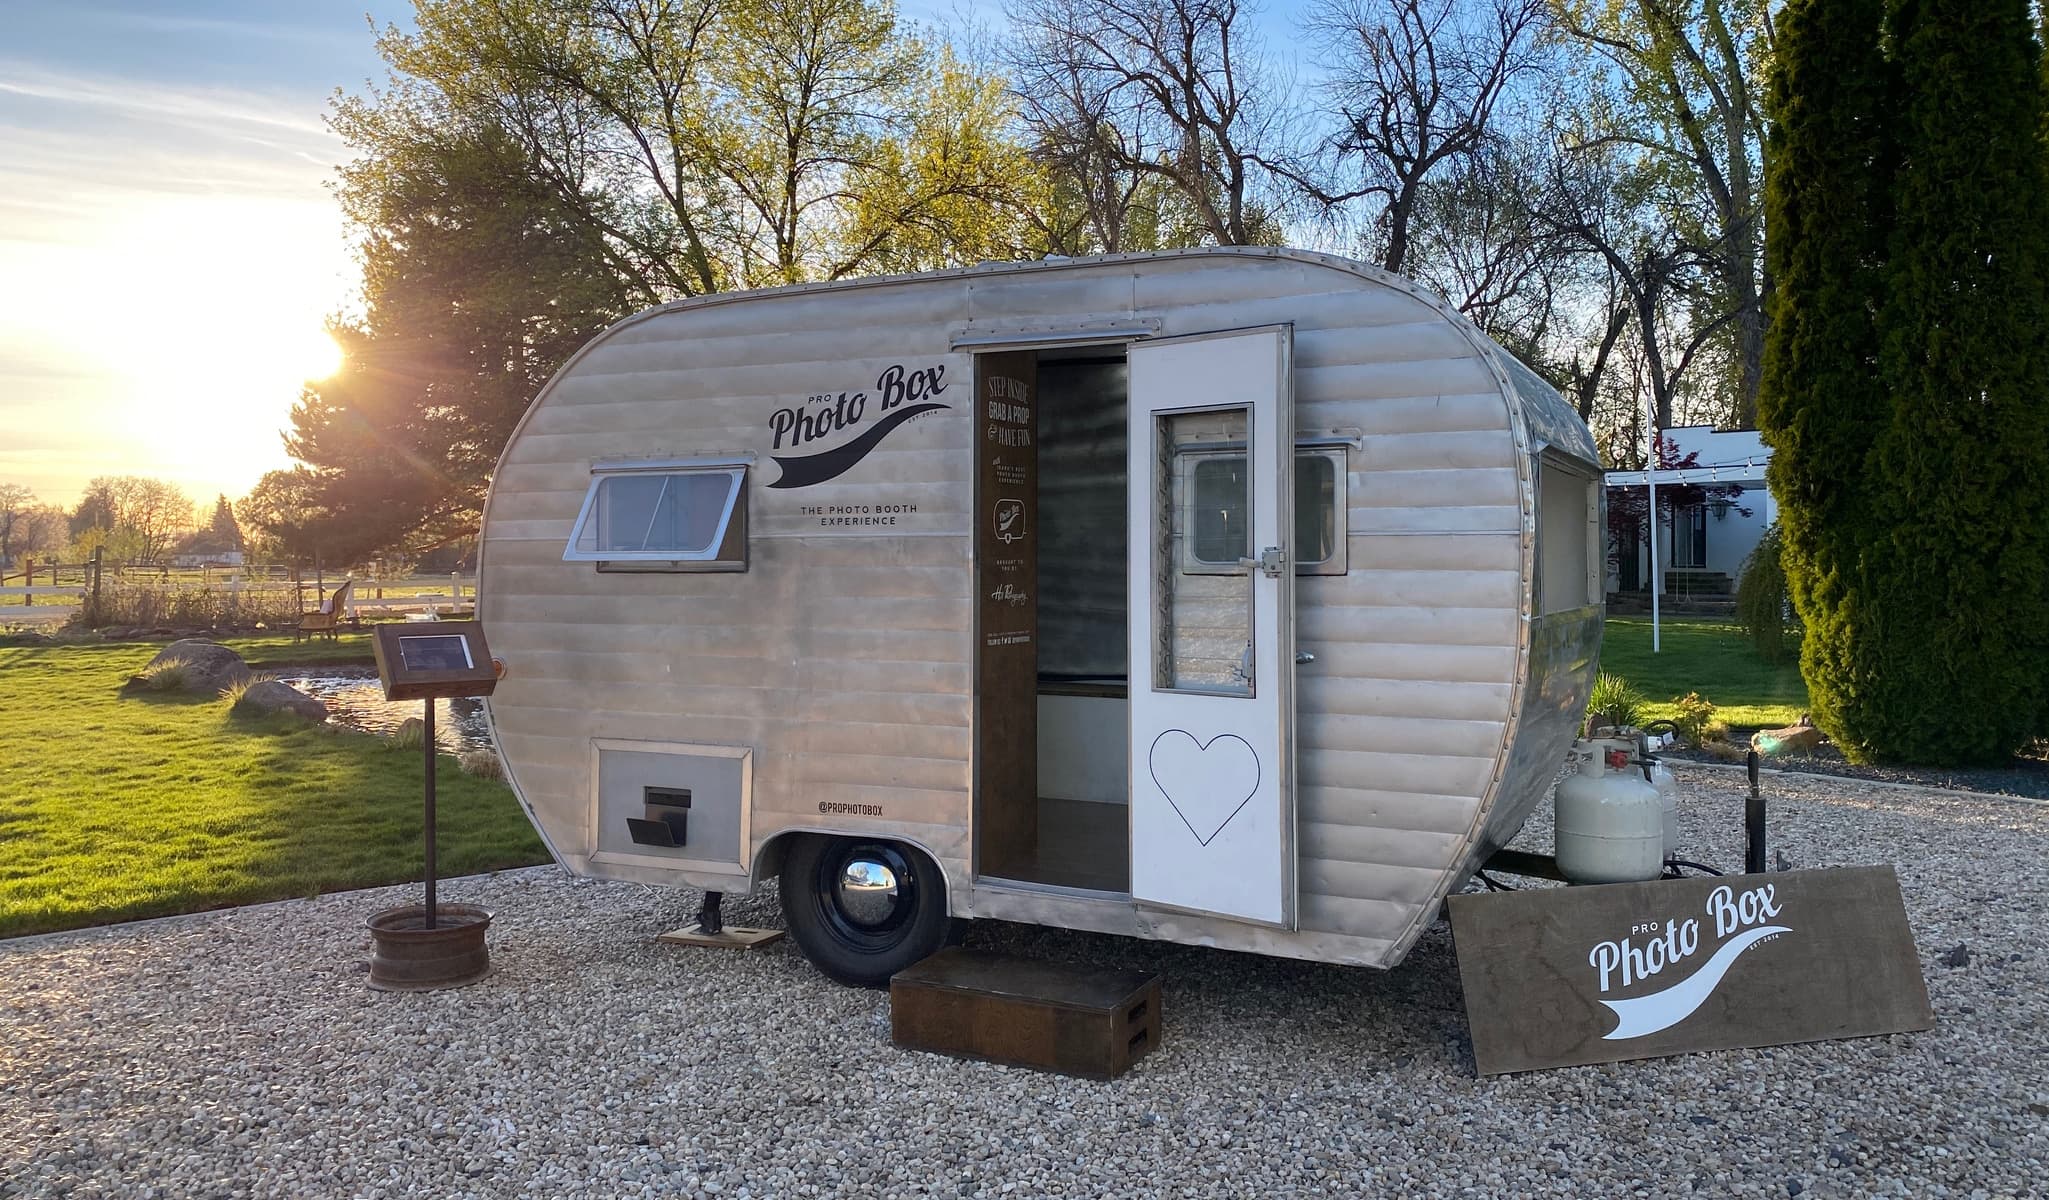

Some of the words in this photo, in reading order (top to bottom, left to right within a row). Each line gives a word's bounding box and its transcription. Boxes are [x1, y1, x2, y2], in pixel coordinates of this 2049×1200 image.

[988, 376, 1006, 398] STEP
[1007, 377, 1030, 403] INSIDE
[769, 392, 867, 449] Photo
[877, 364, 949, 411] Box
[808, 394, 831, 405] PRO
[988, 401, 1006, 421] GRAB
[1007, 404, 1013, 423] A
[1013, 405, 1030, 424] PROP
[998, 426, 1016, 446] HAVE
[1017, 428, 1031, 447] FUN
[801, 506, 822, 515] THE
[829, 505, 869, 514] PHOTO
[876, 504, 917, 513] BOOTH
[821, 516, 896, 526] EXPERIENCE
[819, 801, 883, 816] @PROPHOTOBOX
[1632, 922, 1658, 935] PRO
[1589, 918, 1699, 992] Photo
[1706, 883, 1783, 938] Box
[1749, 940, 1761, 951] EST
